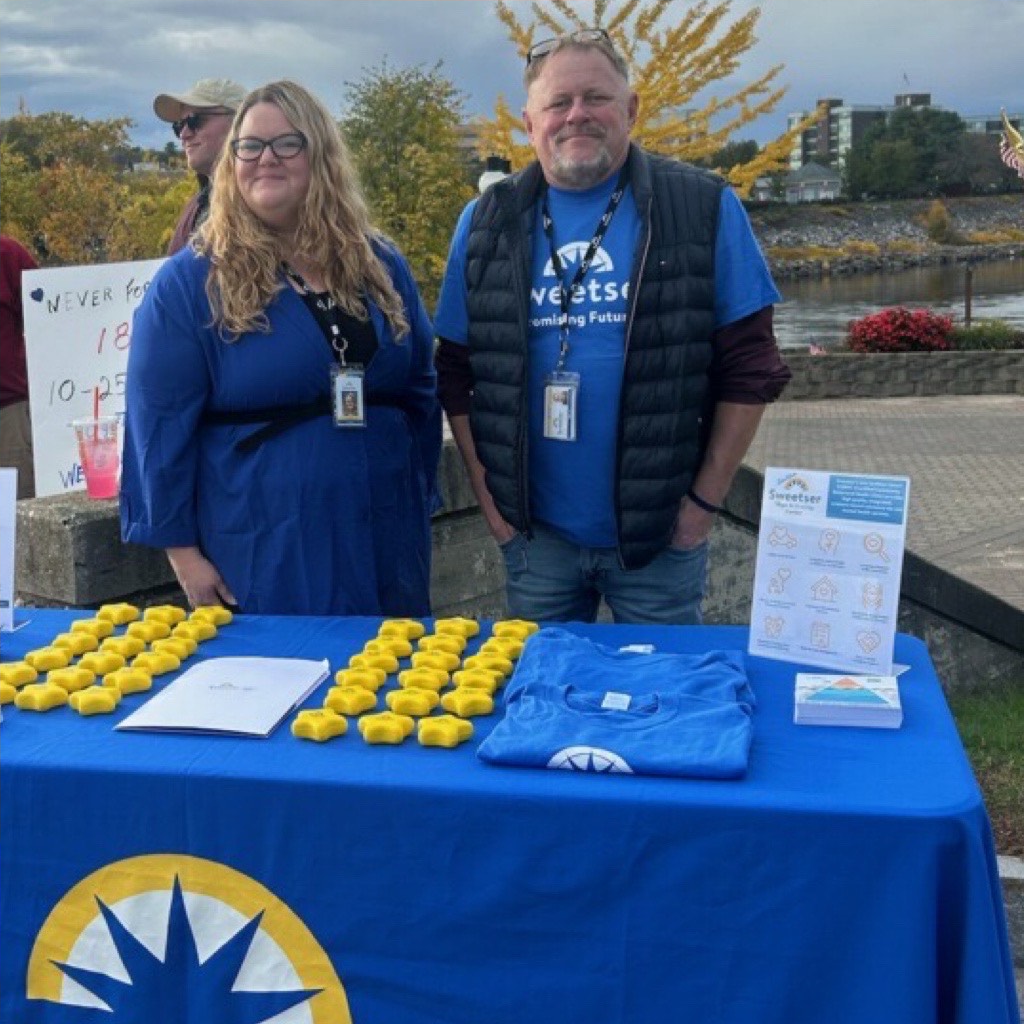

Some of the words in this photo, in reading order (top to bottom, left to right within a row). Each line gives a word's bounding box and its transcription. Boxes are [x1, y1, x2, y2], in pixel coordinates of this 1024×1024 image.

[48, 286, 113, 314] NEVER
[96, 321, 131, 354] 18
[769, 487, 822, 504] Sweetser
